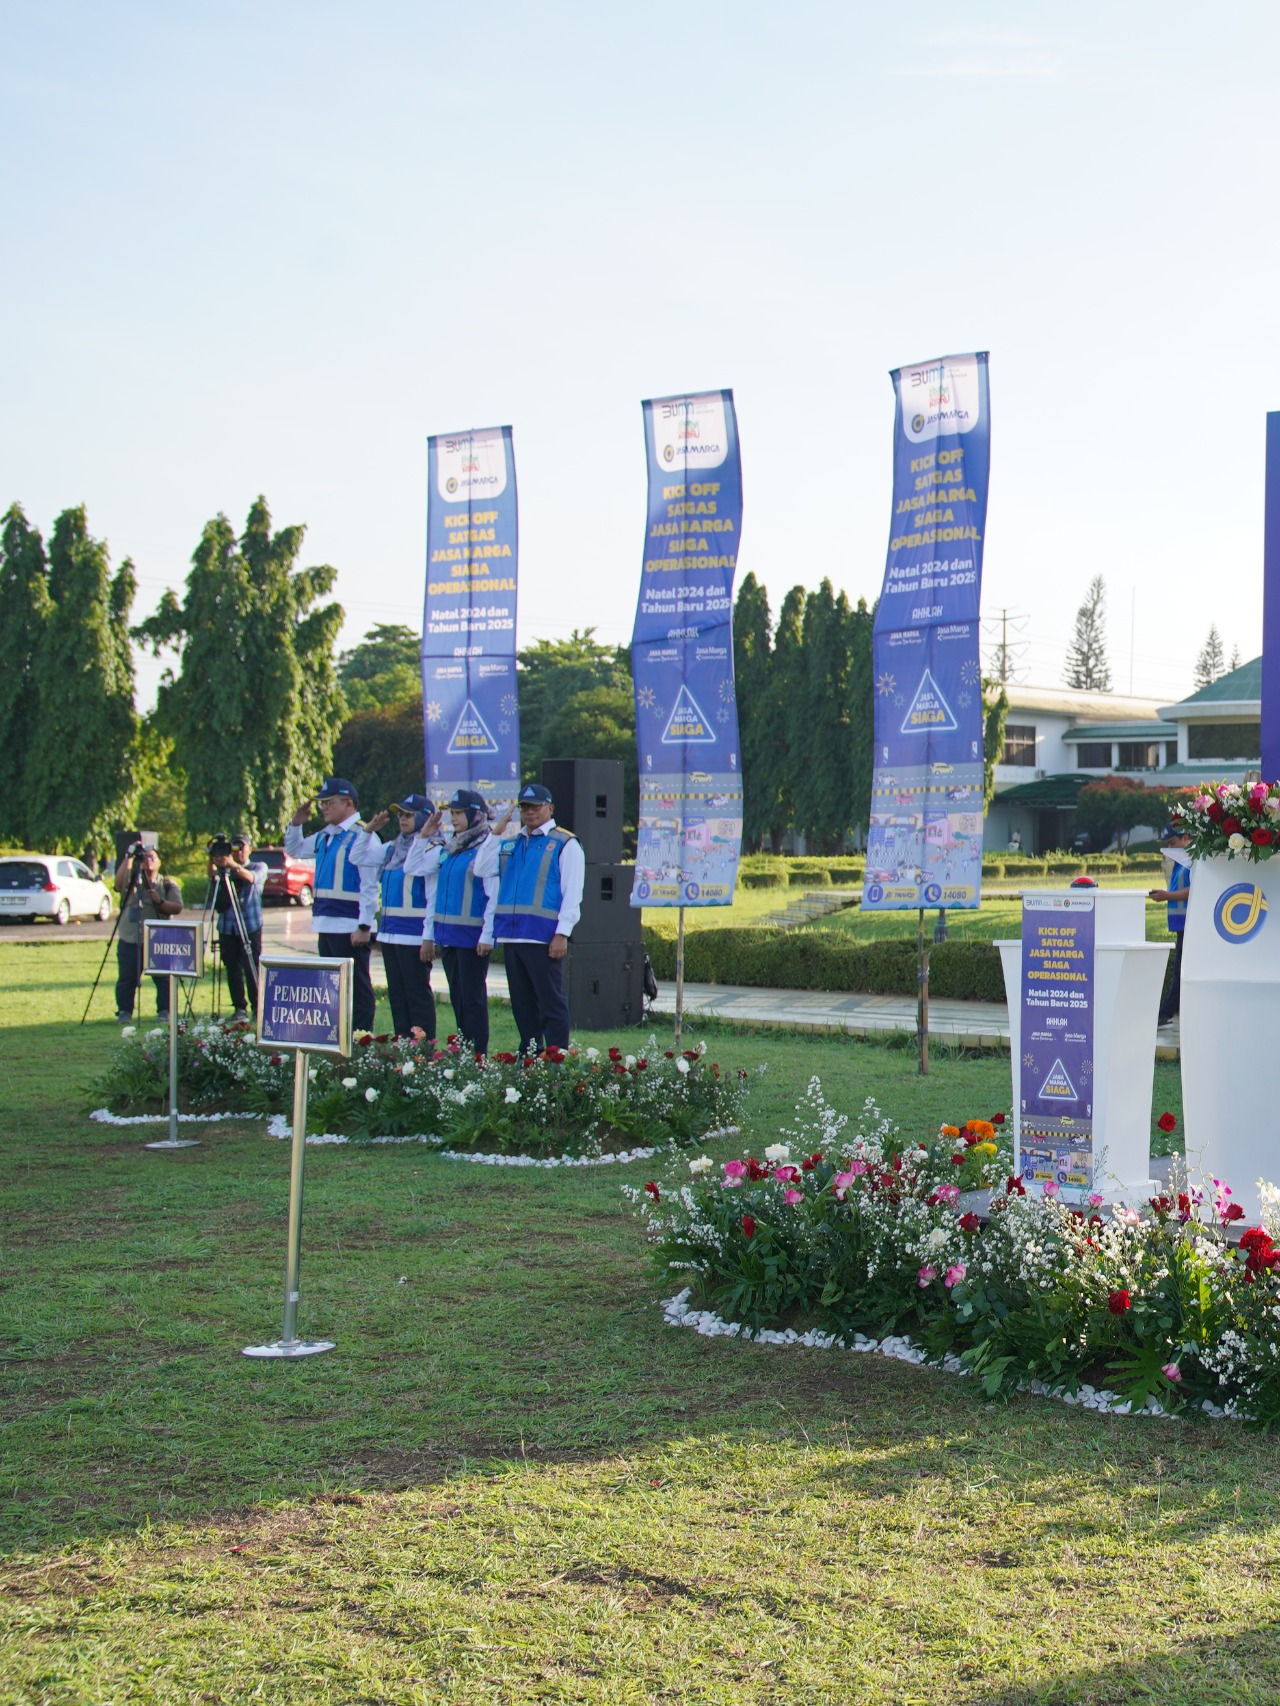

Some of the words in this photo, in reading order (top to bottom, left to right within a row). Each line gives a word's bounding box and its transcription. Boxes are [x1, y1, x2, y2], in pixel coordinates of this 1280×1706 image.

[910, 453, 936, 473] KICK
[938, 448, 964, 464] OFF
[914, 469, 962, 490] SATGAS
[663, 485, 686, 500] KICK
[690, 483, 720, 496] OFF
[896, 495, 925, 514] JASA
[926, 487, 977, 506] MARGA
[667, 501, 716, 517] SATGAS
[444, 514, 469, 528] KICK
[472, 511, 498, 525] OFF
[914, 509, 954, 528] SIAGA
[448, 528, 495, 544] SATGAS
[650, 522, 679, 537] JASA
[668, 538, 708, 553] SIAGA
[890, 526, 981, 551] OPERASIONAL
[431, 548, 461, 562] JASA
[451, 562, 489, 577] SIAGA
[645, 555, 735, 572] OPERASIONAL
[889, 564, 920, 579] Natal
[922, 560, 948, 574] 2024
[950, 558, 972, 570] dan
[428, 578, 516, 595] OPERASIONAL
[885, 580, 918, 594] Tahun
[921, 576, 948, 590] Baru
[950, 571, 976, 585] 2025
[646, 588, 676, 600] Natal
[677, 586, 704, 598] 2024
[706, 585, 725, 596] dan
[641, 602, 676, 614] Tahun
[677, 600, 704, 612] Baru
[706, 598, 730, 610] 2025
[431, 609, 459, 621] Natal
[460, 608, 486, 619] 2024
[487, 607, 508, 617] dan
[427, 621, 458, 633] Tahun
[488, 619, 513, 630] 2025
[937, 626, 949, 634] Jasa
[950, 625, 969, 634] Marga
[696, 646, 708, 654] Jasa
[709, 646, 727, 655] Marga
[920, 692, 935, 701] JASA
[916, 700, 939, 710] MARGA
[911, 709, 946, 724] SIAGA
[670, 724, 704, 736] SIAGA
[455, 736, 487, 746] SIAGA
[701, 889, 722, 897] 14080
[944, 890, 966, 899] 14080
[1038, 927, 1058, 936] KICK
[1060, 927, 1076, 936] OFF
[153, 943, 191, 956] DIREKSI
[1041, 938, 1074, 947] SATGAS
[1029, 950, 1051, 958] JASA
[1052, 950, 1084, 959] MARGA
[1043, 960, 1070, 969] SIAGA
[1028, 972, 1088, 981] OPERASIONAL
[274, 985, 330, 1004] PEMBINA
[1028, 988, 1048, 997] Natal
[1050, 990, 1068, 998] 2024
[1070, 990, 1084, 999] dan
[1026, 998, 1049, 1006] Tahun
[1051, 998, 1068, 1007] Baru
[1070, 1000, 1088, 1008] 2025
[272, 1006, 331, 1026] UPACARA
[1045, 1086, 1070, 1095] SIAGA
